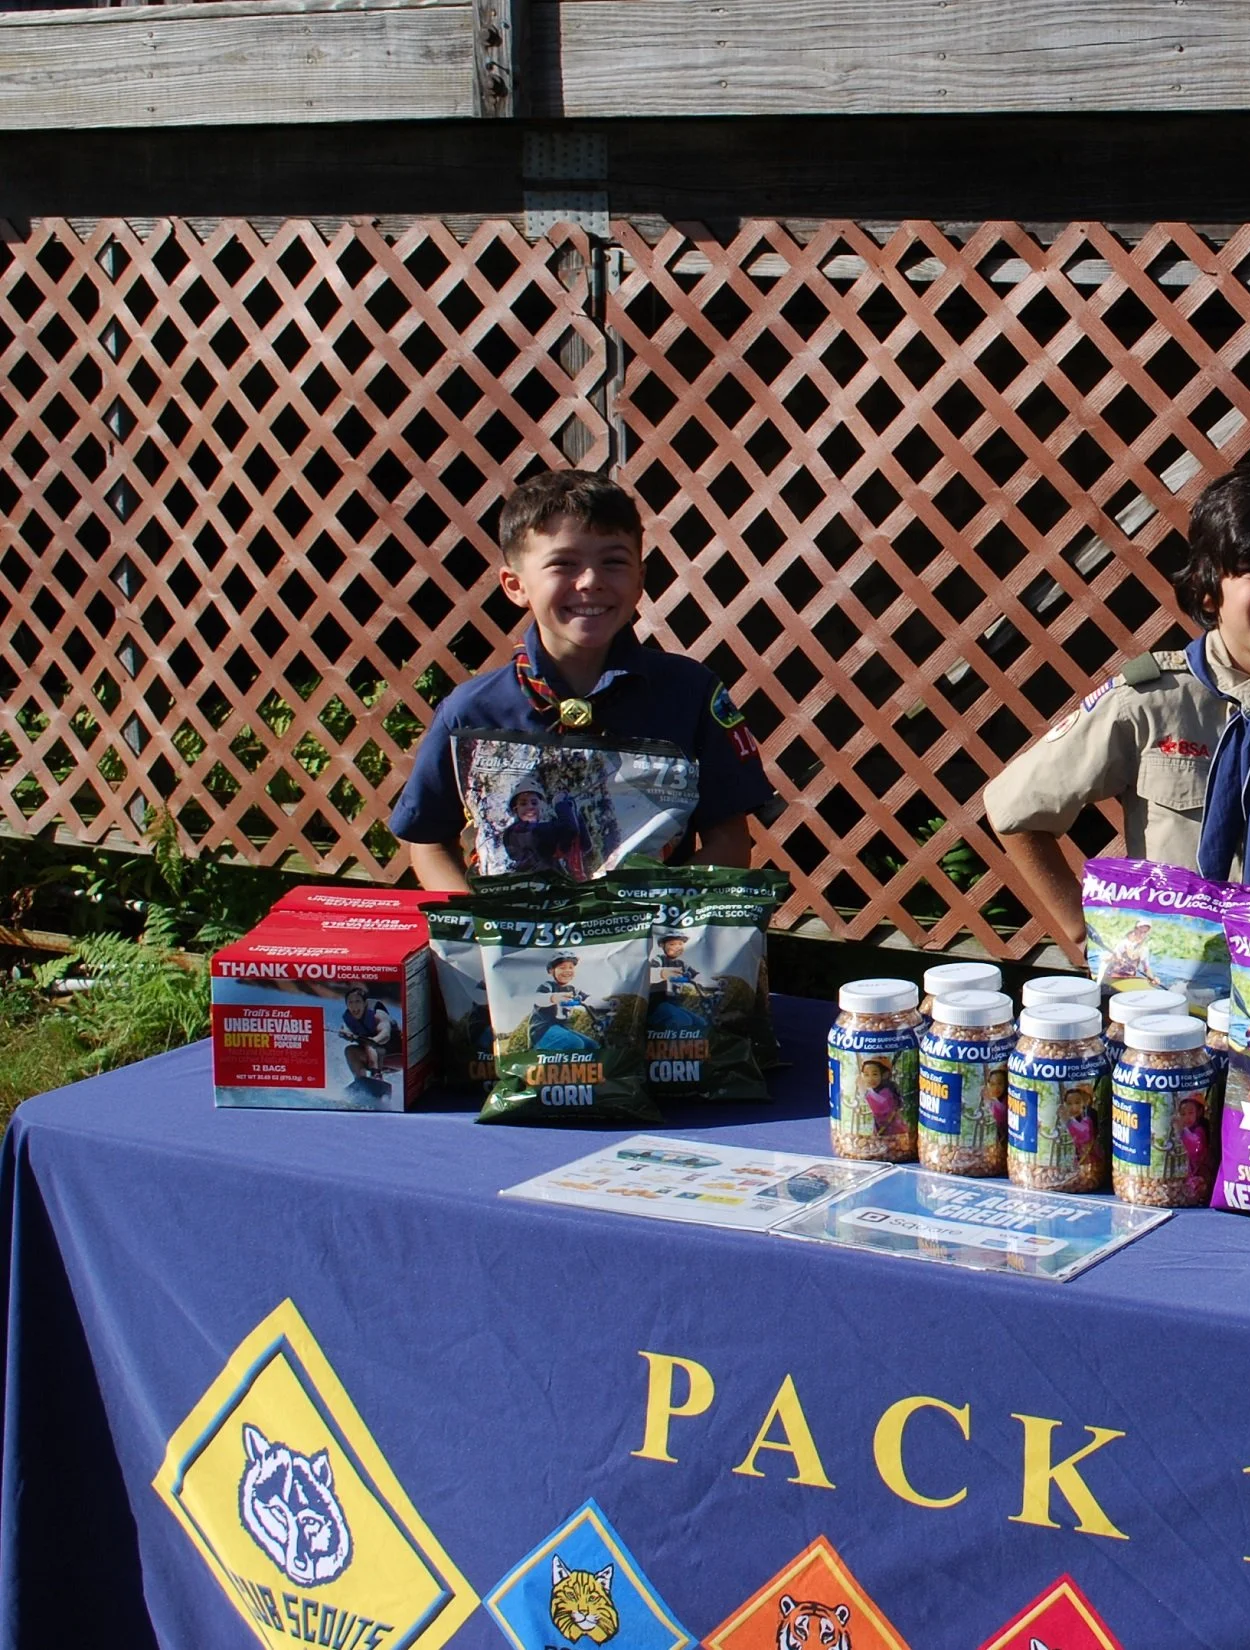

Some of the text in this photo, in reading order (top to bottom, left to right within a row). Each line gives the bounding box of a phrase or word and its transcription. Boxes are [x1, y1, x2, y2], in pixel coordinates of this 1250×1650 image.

[1178, 740, 1211, 757] BSA
[617, 889, 648, 898] OVER
[1083, 875, 1211, 909] THANK YOU FOR
[651, 902, 695, 928] 3%
[695, 910, 724, 922] LOCAL
[1187, 901, 1220, 914] LOCAL
[428, 913, 459, 925] OVER
[484, 920, 514, 932] OVER
[515, 921, 583, 947] 73%
[581, 917, 630, 930] SUPPORTS
[632, 912, 652, 923] OUR
[582, 922, 652, 938] LOCAL SCOUTS
[218, 961, 289, 978] THANK
[294, 964, 337, 979] YOU
[353, 966, 398, 974] SUPPORTING
[243, 1008, 291, 1018] Trail's End
[223, 1017, 313, 1034] UNBELIEVABLE
[223, 1032, 271, 1049] BUTTER
[648, 1029, 700, 1041] Trail's End
[537, 1052, 594, 1065] Trail's End
[647, 1039, 711, 1061] ARAMEL
[956, 1045, 992, 1060] YOU
[251, 1064, 287, 1072] 12 BAGS
[525, 1062, 606, 1086] CARAMEL
[649, 1060, 701, 1083] CORN
[1032, 1063, 1067, 1079] YOU
[1144, 1074, 1181, 1090] YOU
[540, 1084, 594, 1107] CORN
[926, 1185, 982, 1206] WE
[977, 1196, 1093, 1223] ACCEPT
[933, 1204, 1042, 1230] CREDIT
[630, 1349, 1130, 1540] PACK
[281, 1591, 396, 1650] SCOUTS
